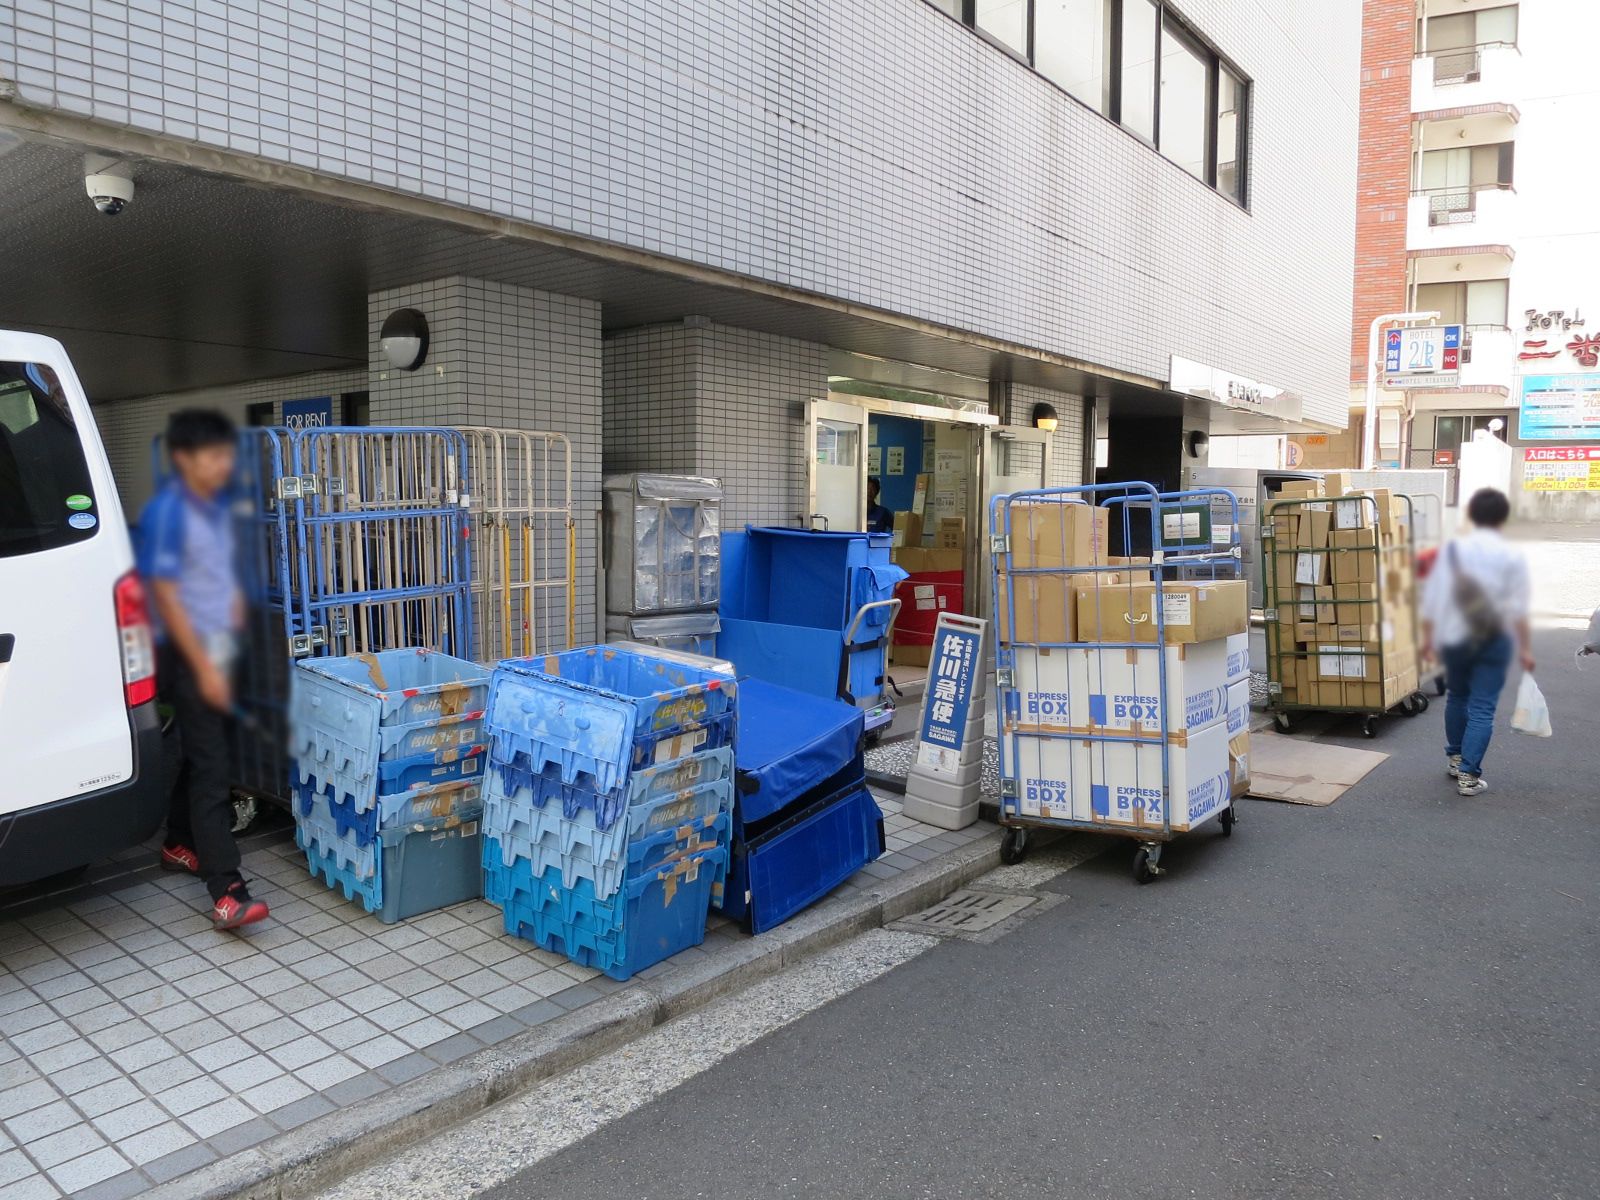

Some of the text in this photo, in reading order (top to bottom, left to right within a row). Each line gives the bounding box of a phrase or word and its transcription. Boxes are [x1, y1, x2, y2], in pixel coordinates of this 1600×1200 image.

[1524, 308, 1585, 331] HOTEL
[1410, 330, 1435, 339] HOTEL
[1445, 334, 1457, 342] OK
[1444, 355, 1457, 363] NO
[286, 412, 327, 429] FOR RENT
[1527, 449, 1586, 460] 入口はこちら
[1192, 472, 1197, 480] 5
[932, 634, 965, 724] 佐川急便
[1028, 692, 1067, 701] EXPRESS
[1114, 695, 1158, 704] EXPRESS
[1028, 701, 1067, 715] BOX
[1114, 704, 1158, 720] BOX
[1186, 707, 1214, 729] SAGAWA
[928, 731, 956, 744] SAGAWA
[1027, 779, 1066, 789] EXPRESS
[1027, 787, 1066, 803] BOX
[1117, 787, 1161, 797] EXPRESS
[1117, 795, 1161, 812] BOX
[1189, 796, 1215, 822] SAGAWA
